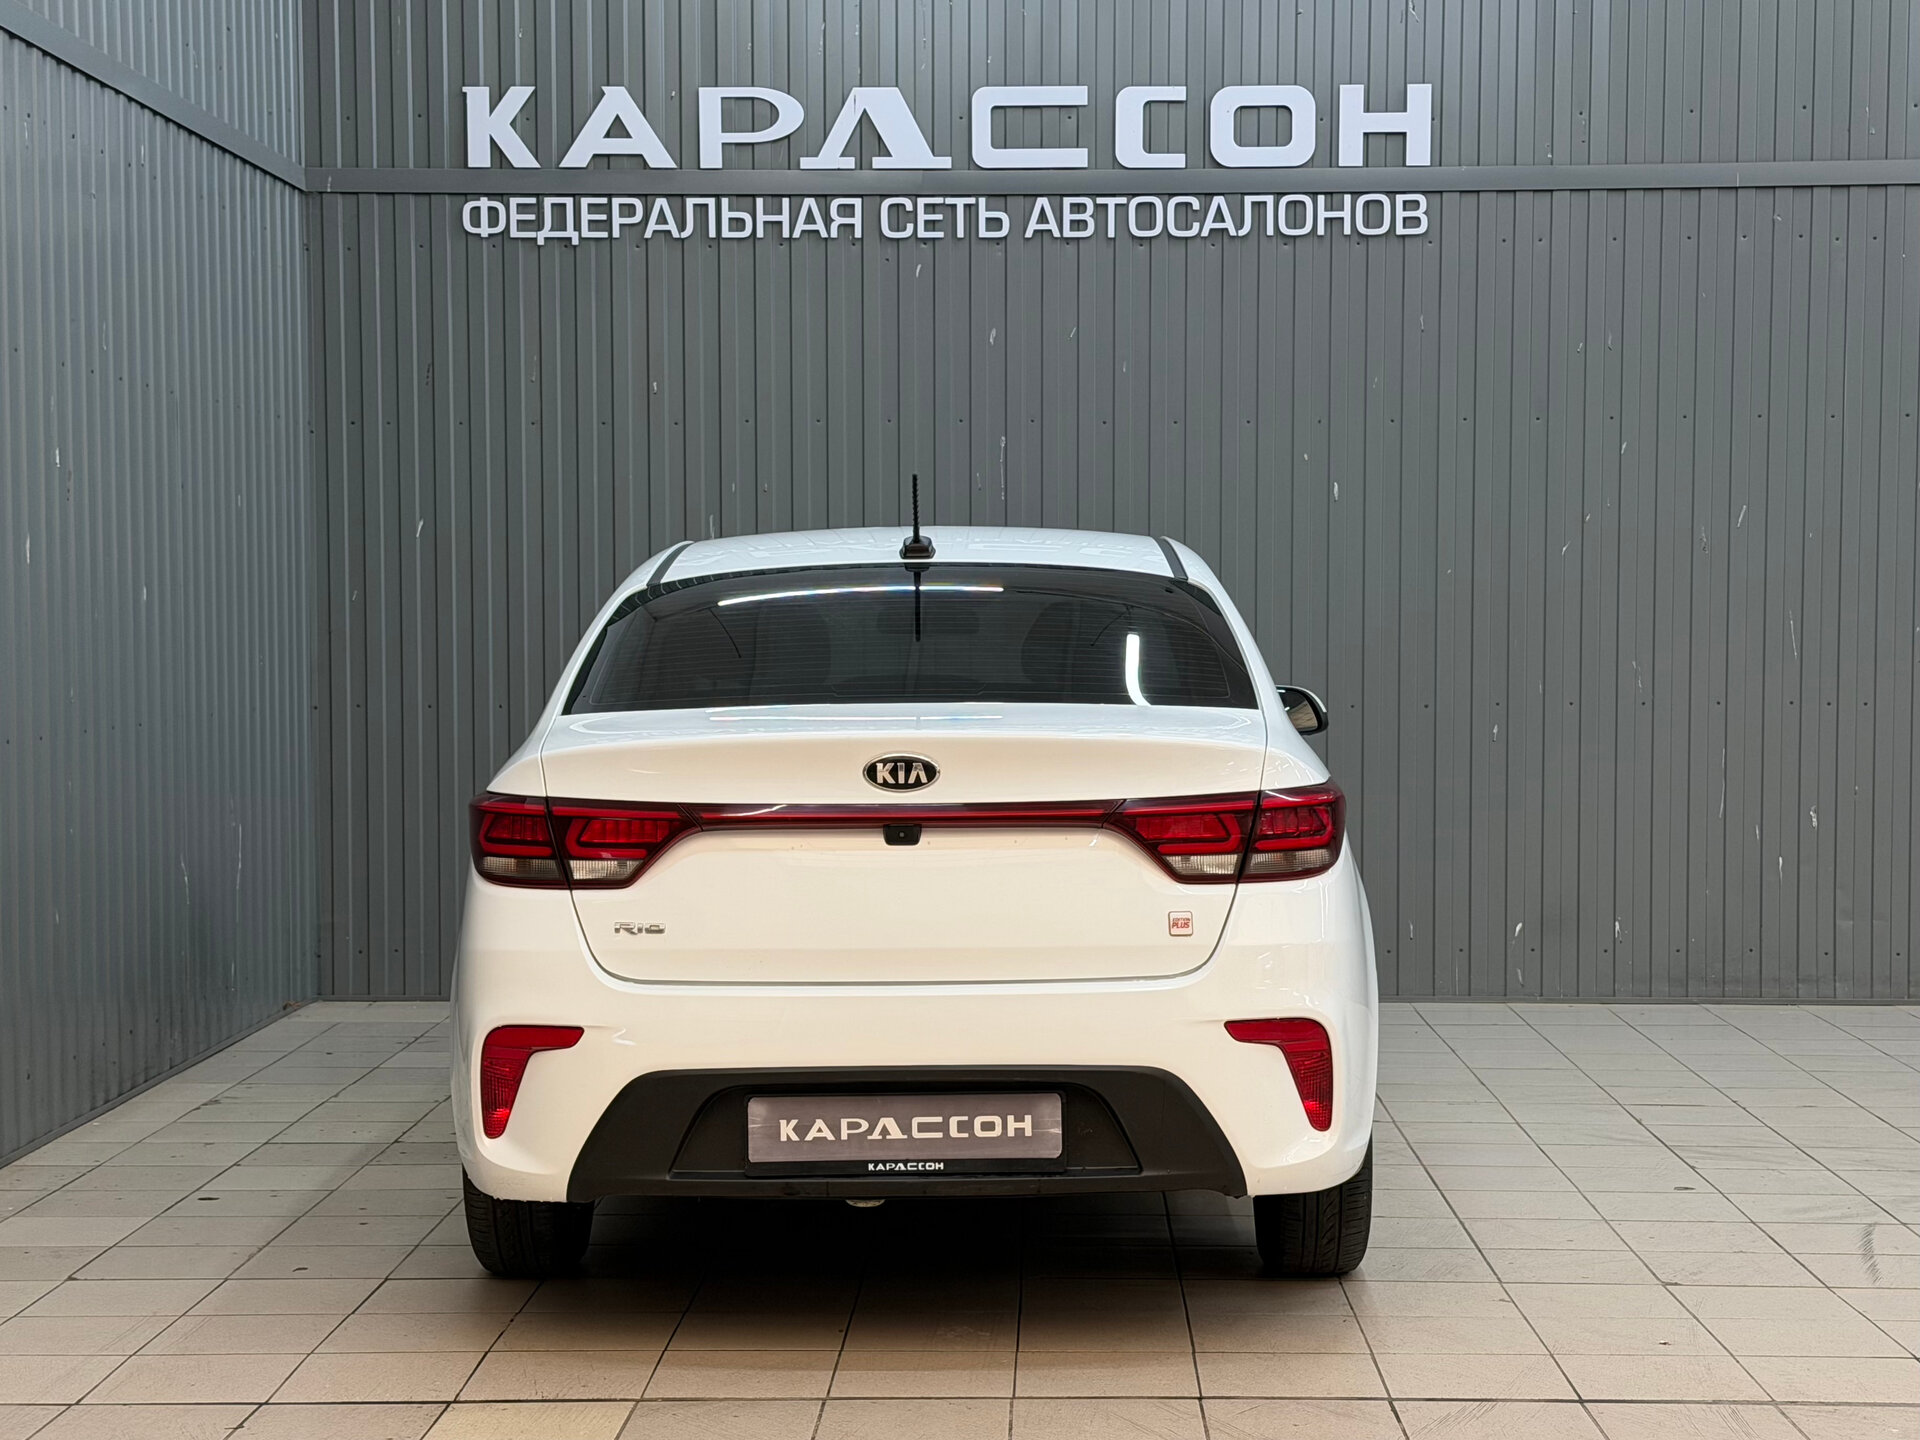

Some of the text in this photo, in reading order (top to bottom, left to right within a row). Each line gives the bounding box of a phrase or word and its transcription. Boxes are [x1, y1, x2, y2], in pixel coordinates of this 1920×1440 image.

[462, 193, 1429, 246] ФЕДЕРАЛЬНАЯ СЕТЬ АВТОСАЛОНОВ
[875, 762, 928, 784] KIA
[1172, 921, 1190, 929] PLUS
